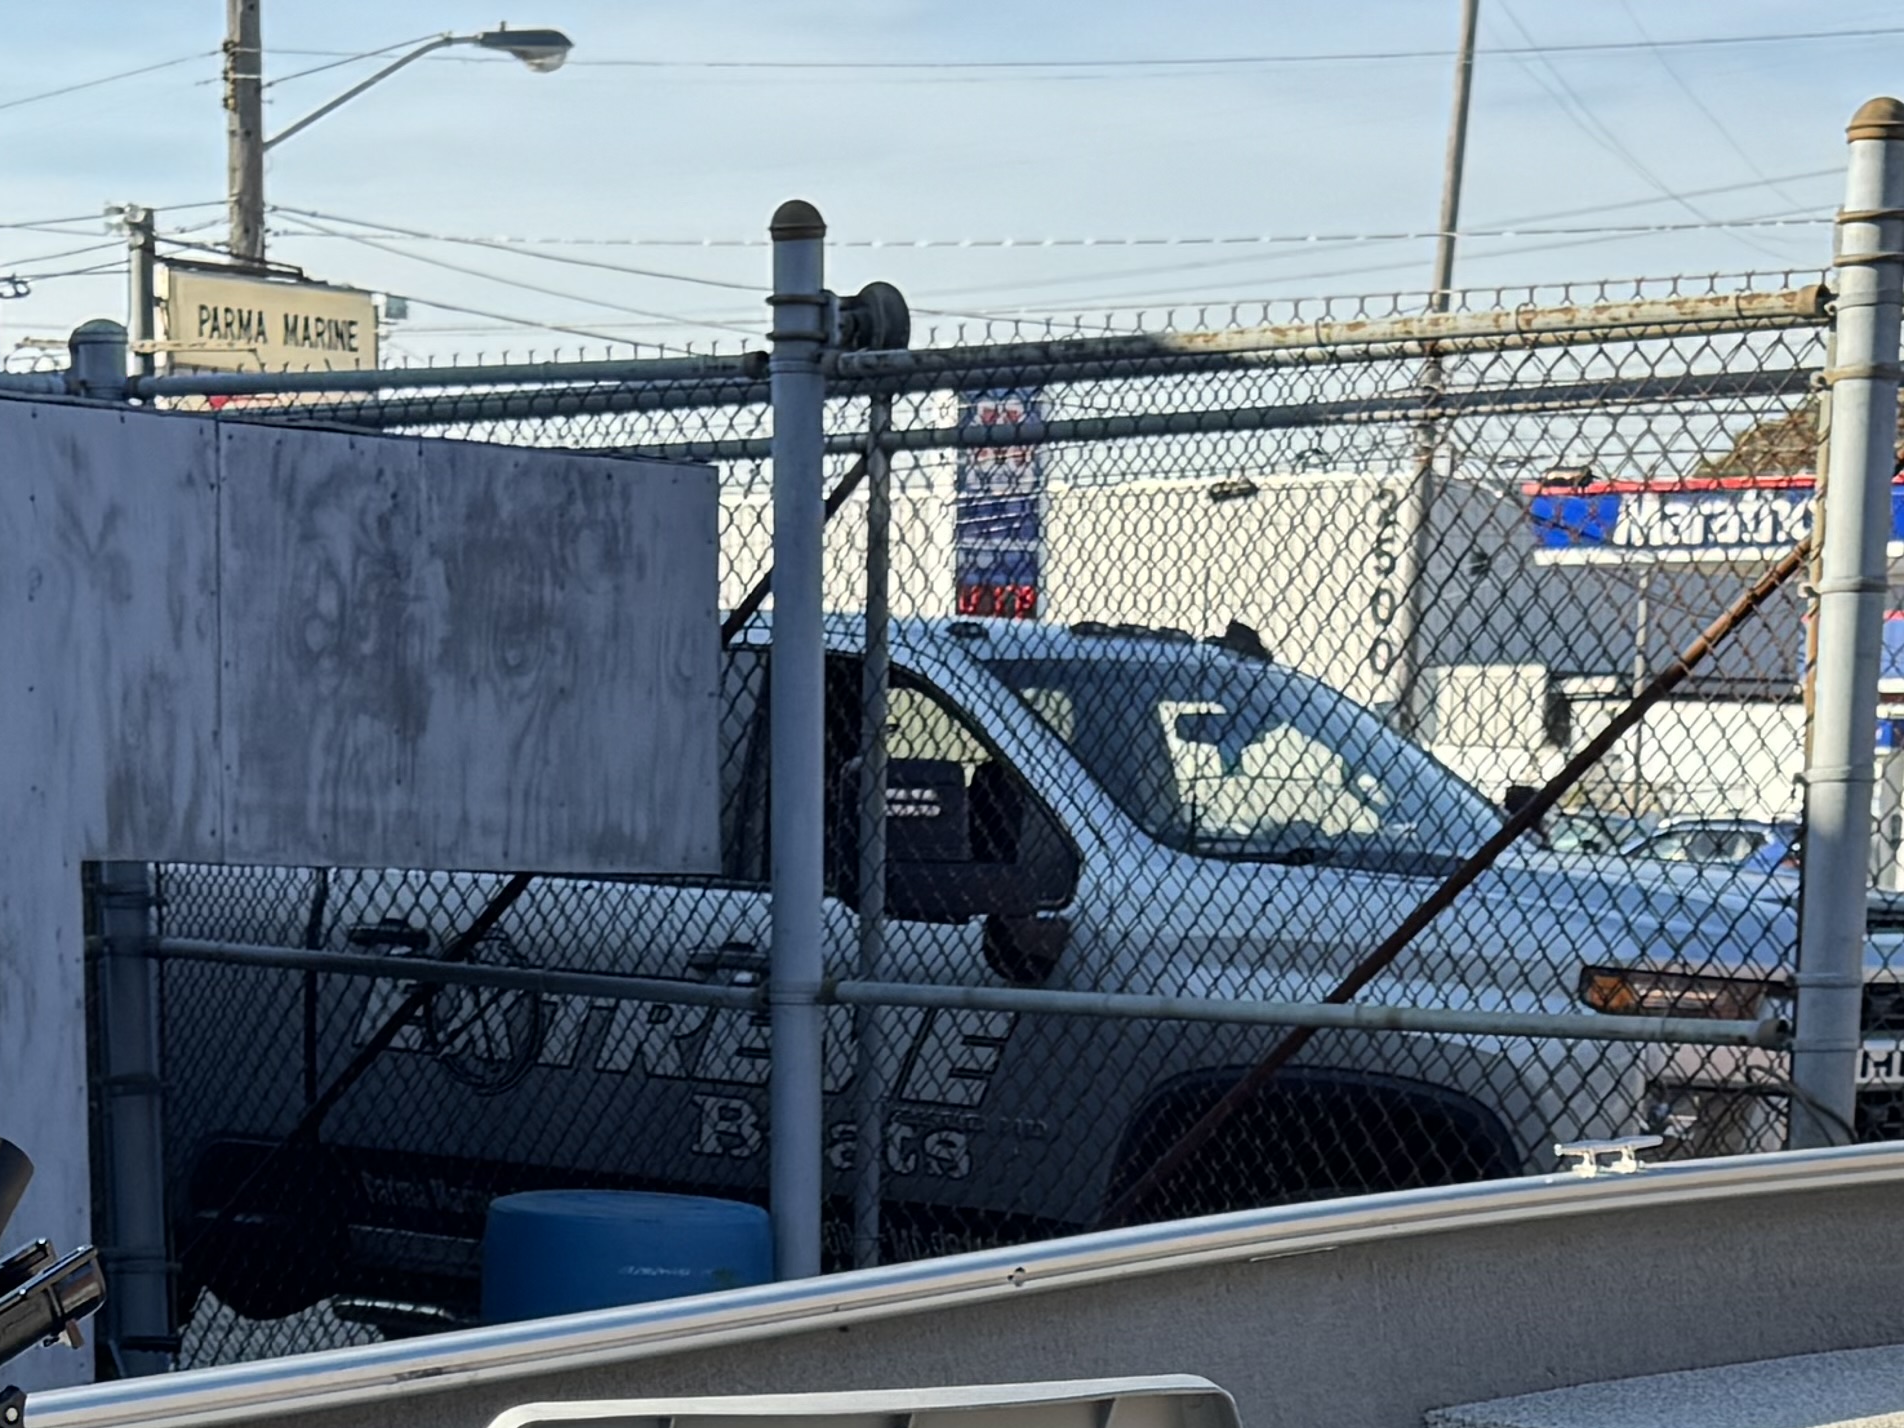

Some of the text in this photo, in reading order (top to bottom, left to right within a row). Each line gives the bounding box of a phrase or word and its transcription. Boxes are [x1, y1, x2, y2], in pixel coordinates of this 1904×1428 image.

[198, 304, 359, 353] PARMA MARINE
[1611, 490, 1818, 547] Maratho
[691, 1092, 972, 1181] Bats
